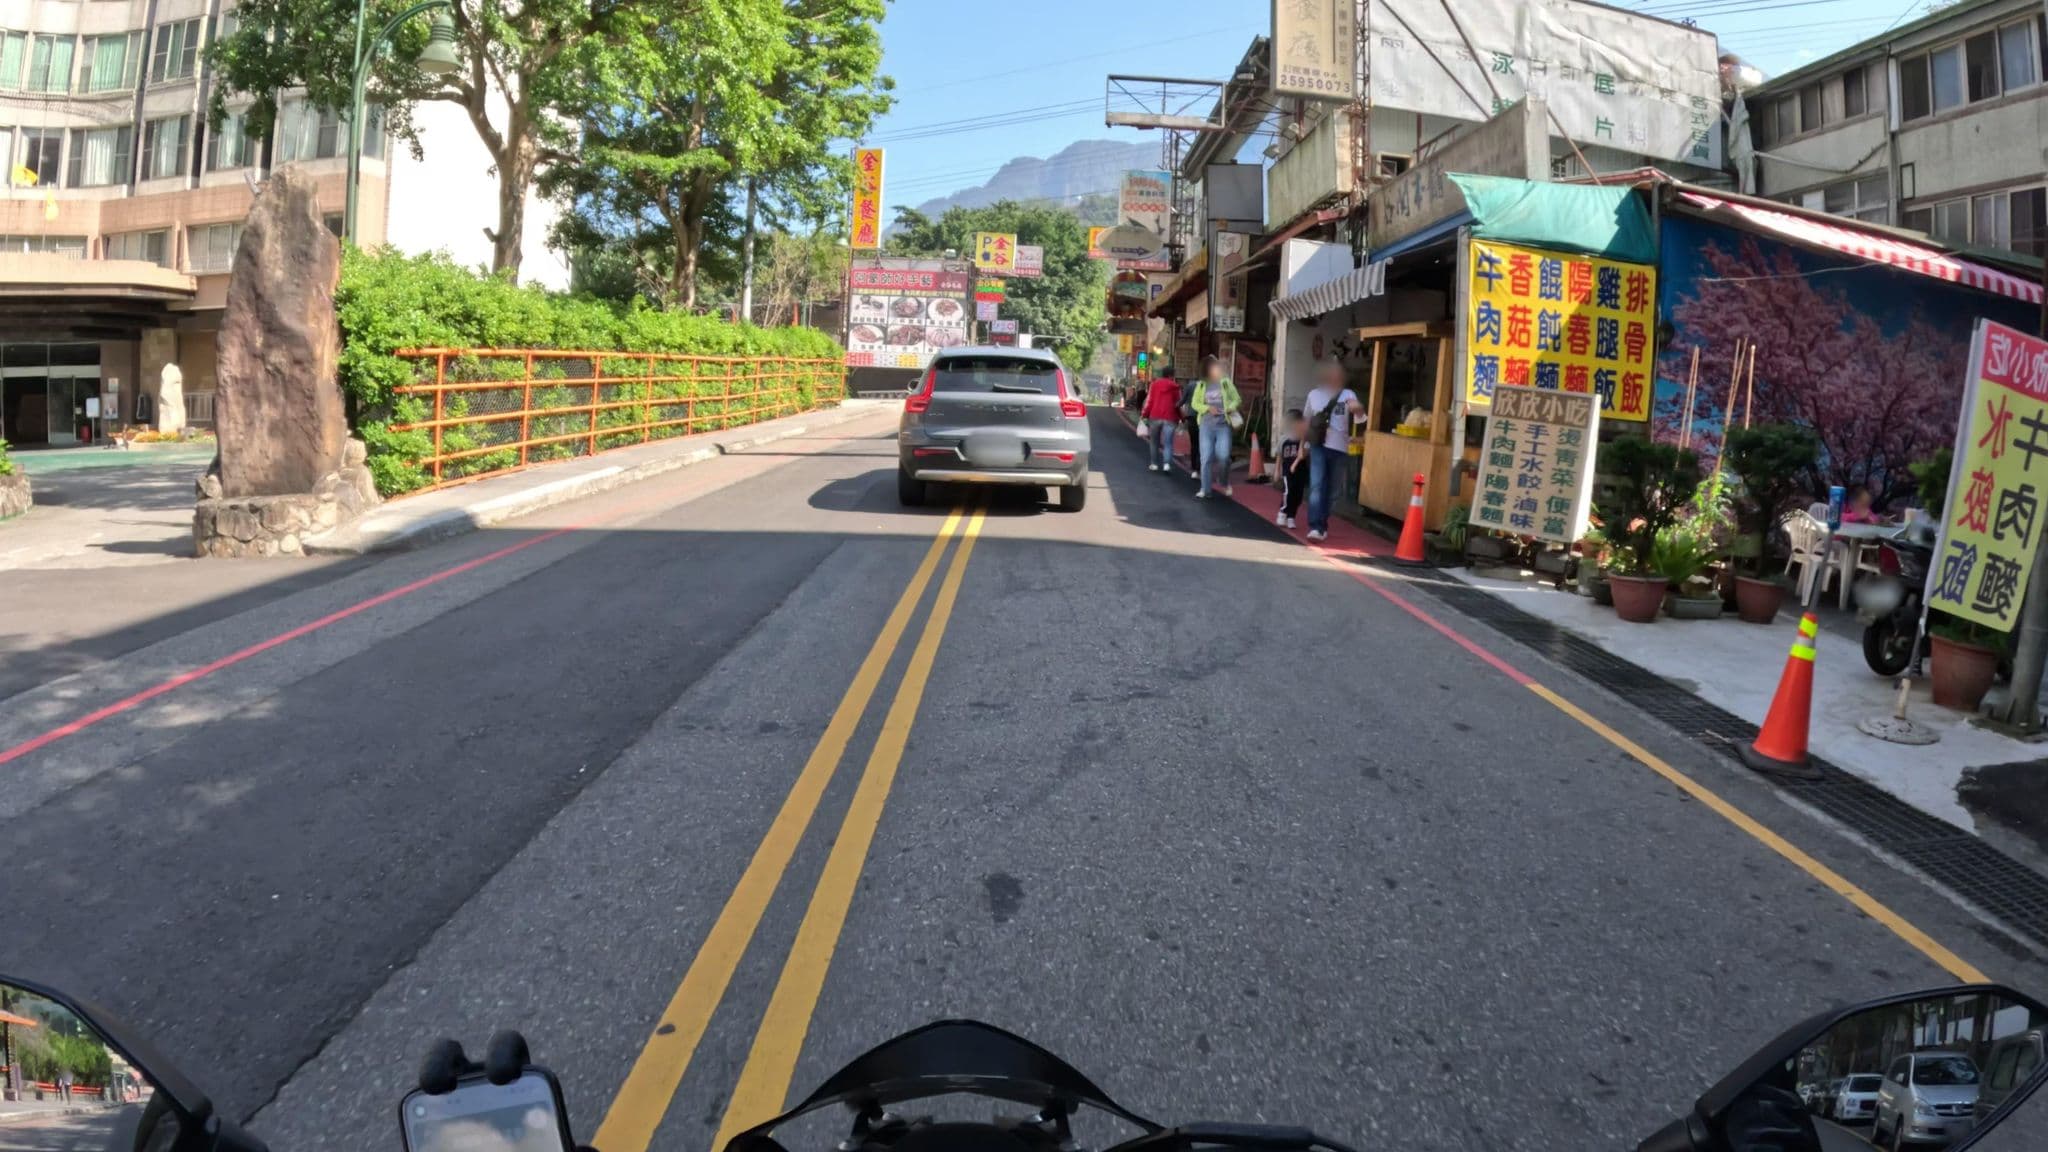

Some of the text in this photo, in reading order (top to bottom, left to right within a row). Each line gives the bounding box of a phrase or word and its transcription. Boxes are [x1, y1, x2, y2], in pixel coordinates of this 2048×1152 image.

[1280, 74, 1351, 93] 25950073
[1594, 73, 1615, 140] 底片
[983, 236, 993, 248] P
[992, 236, 1012, 265] 金谷
[1472, 249, 1503, 398] 牛肉麵
[1504, 254, 1533, 386] 香菇麵
[1534, 258, 1563, 391] 餛飩麵
[1593, 266, 1622, 410] 雞腿飯
[1619, 271, 1649, 415] 排骨飯
[1494, 391, 1589, 426] 欣欣小吃
